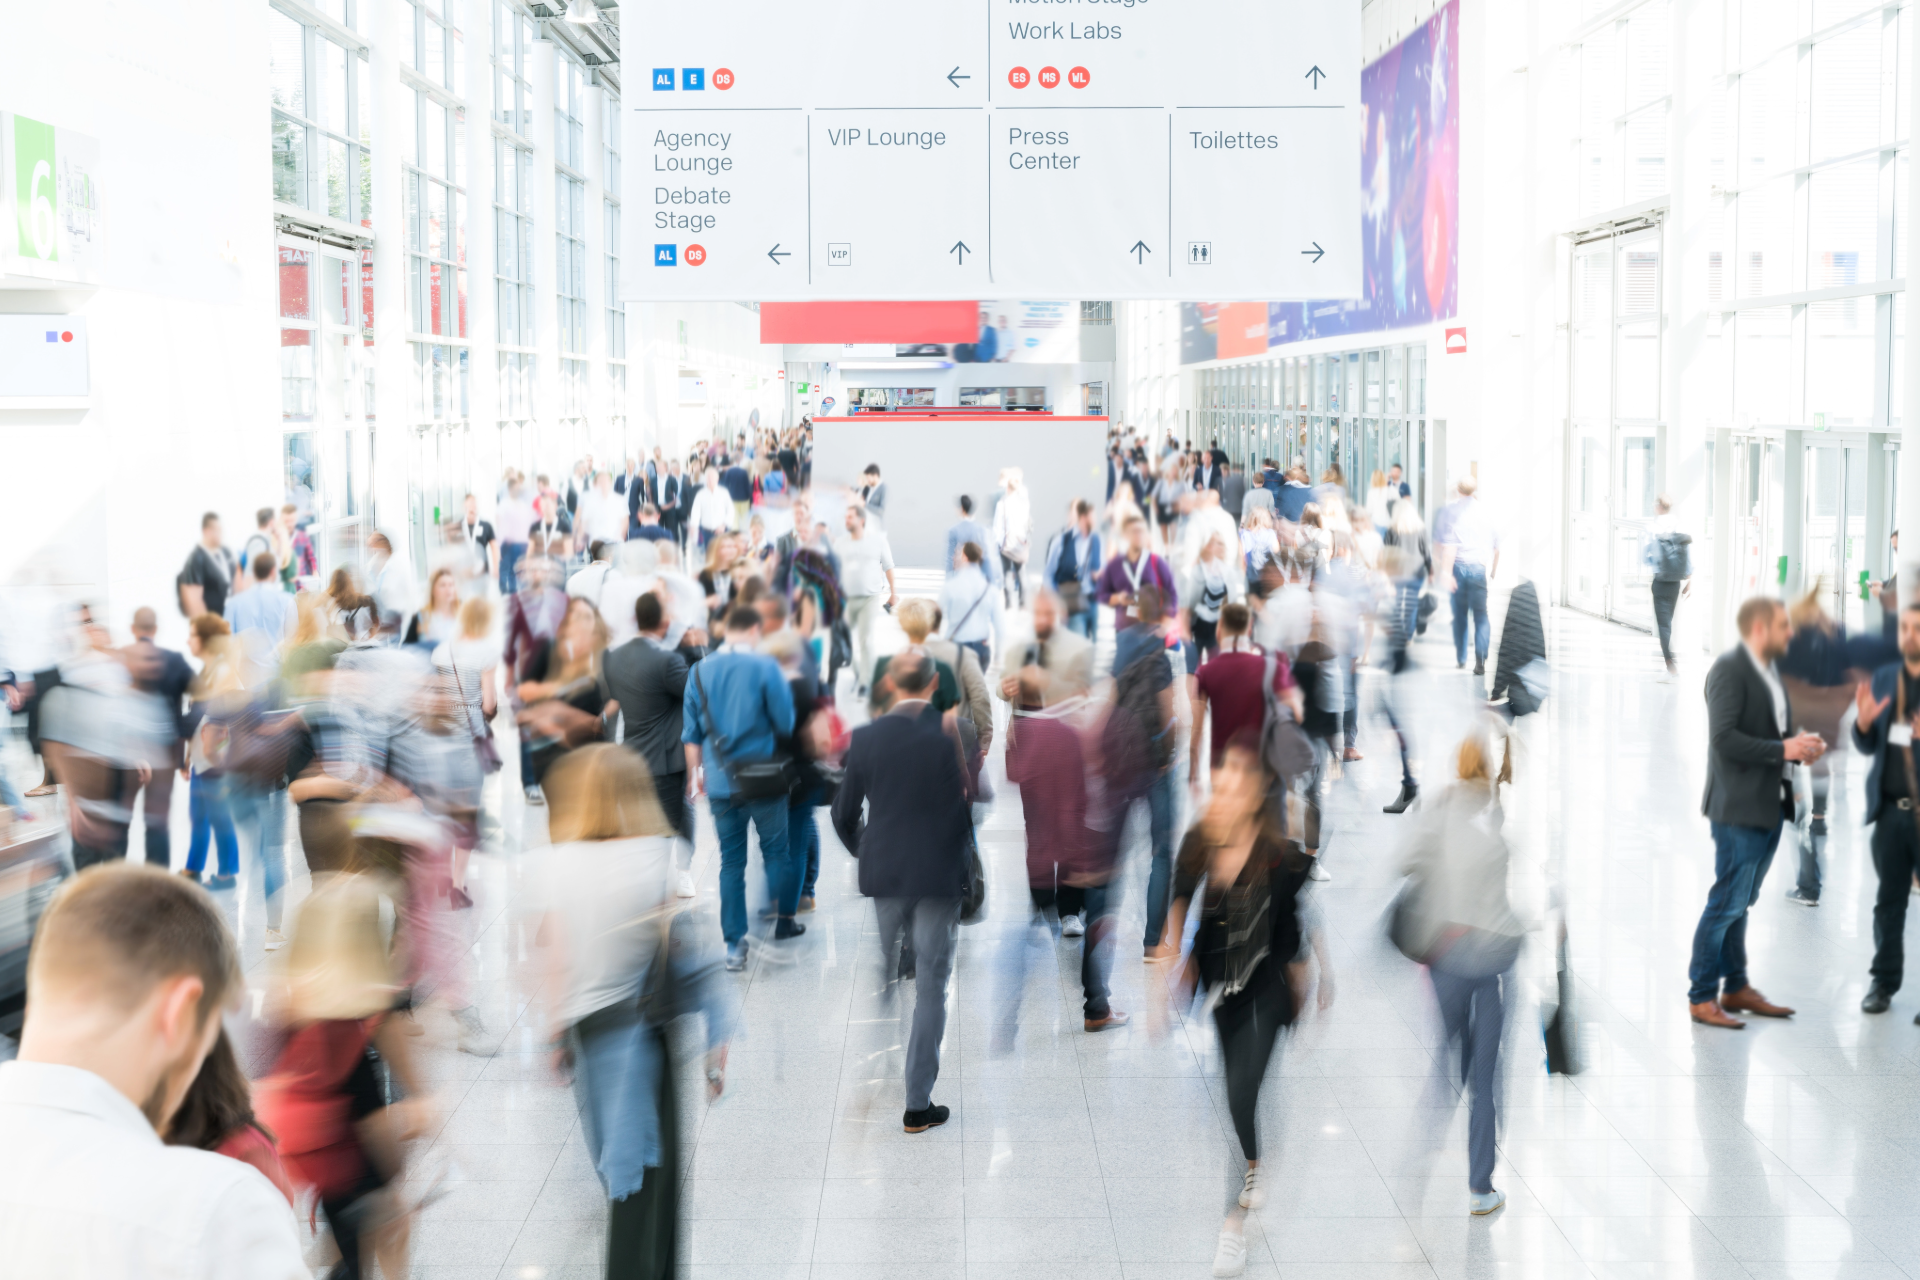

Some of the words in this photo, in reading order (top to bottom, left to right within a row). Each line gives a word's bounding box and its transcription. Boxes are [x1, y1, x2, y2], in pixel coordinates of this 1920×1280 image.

[1008, 21, 1064, 40] Work
[1070, 20, 1123, 40] Labs
[656, 74, 671, 85] AL
[690, 74, 698, 85] E
[716, 73, 731, 85] DS
[1012, 72, 1027, 83] ES
[1042, 72, 1057, 83] MS
[1071, 72, 1087, 83] WL
[653, 129, 732, 151] Agency
[827, 128, 861, 146] VIP
[867, 128, 947, 150] Lounge
[1008, 127, 1070, 146] Press
[1189, 130, 1279, 150] Toilettes
[654, 154, 733, 176] Lounge
[1008, 151, 1081, 170] Center
[655, 186, 731, 205] Debate
[31, 159, 54, 261] 6
[654, 210, 717, 233] Stage
[658, 250, 673, 261] AL
[688, 250, 702, 261] DS
[831, 250, 848, 259] VIP
